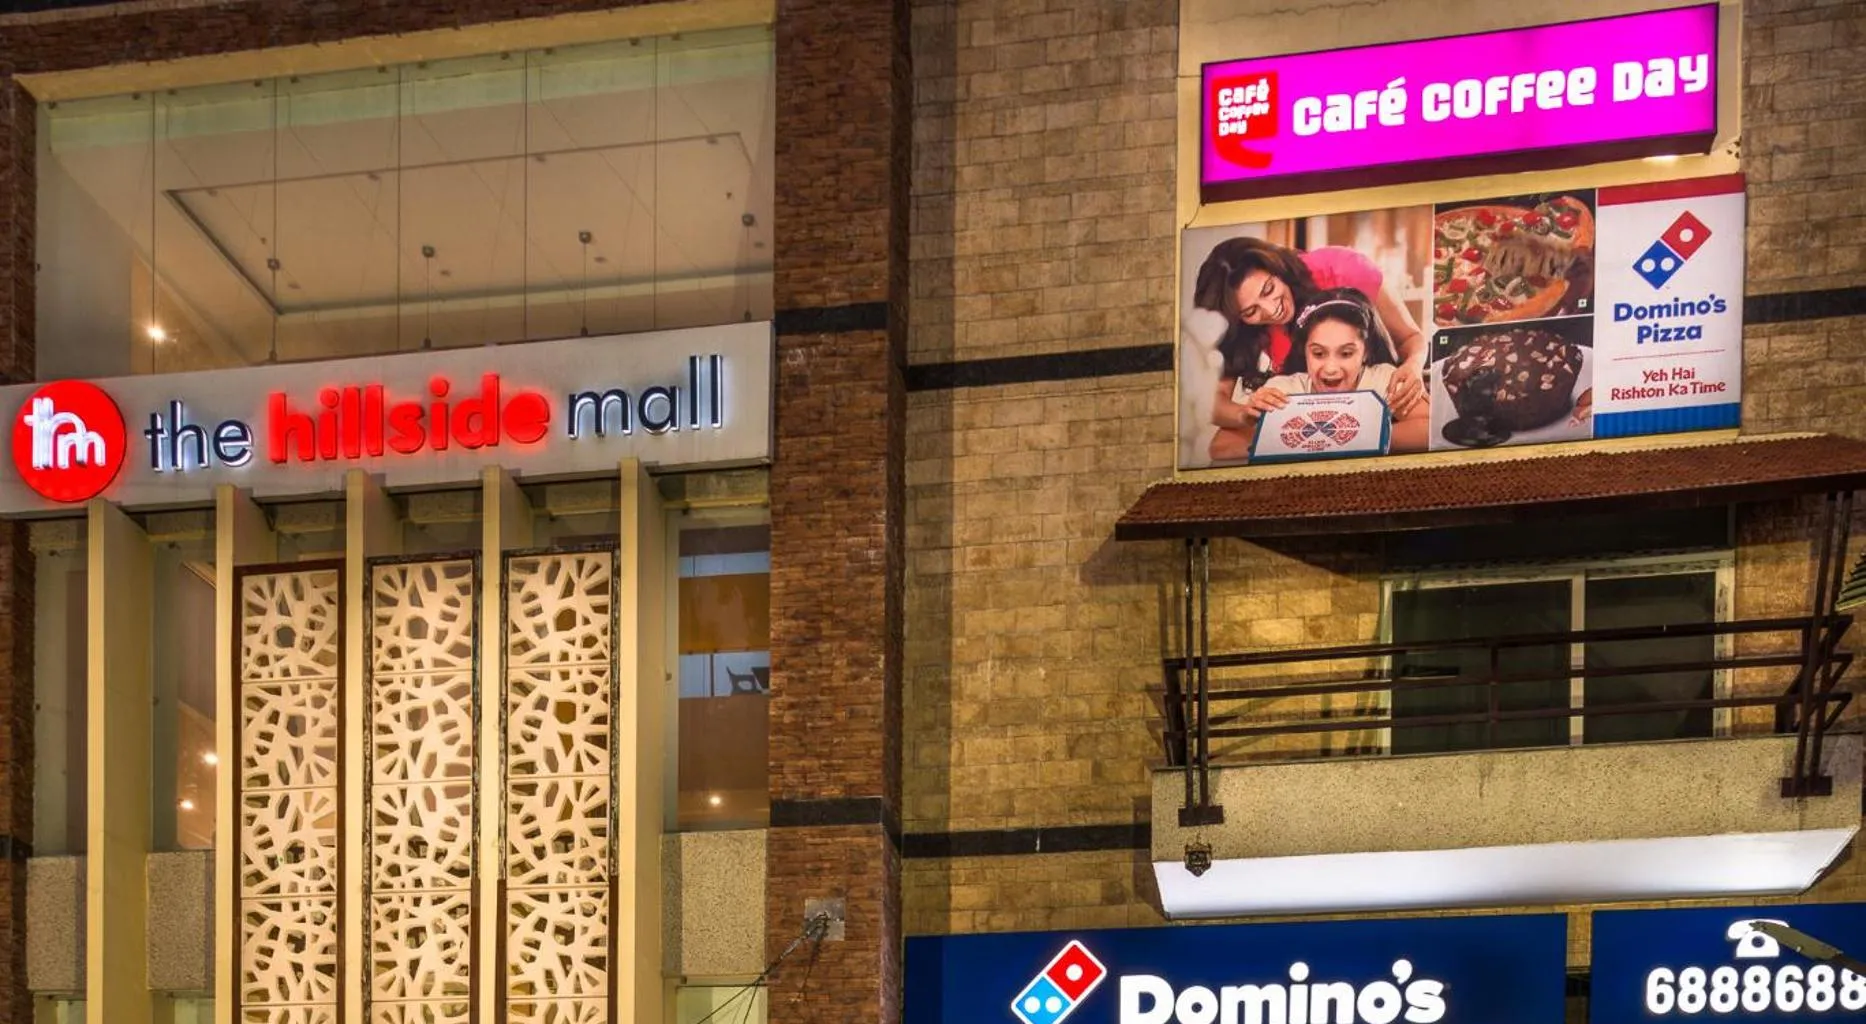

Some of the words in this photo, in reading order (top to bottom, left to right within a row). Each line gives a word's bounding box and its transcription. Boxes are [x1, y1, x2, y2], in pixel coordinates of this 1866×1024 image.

[1421, 66, 1597, 123] Coffee
[1612, 53, 1710, 103] Day
[1613, 293, 1727, 322] Domino's
[1636, 322, 1703, 344] Pizza
[1642, 369, 1669, 384] Yeh
[1671, 367, 1696, 381] Hai
[1611, 387, 1665, 401] Rishton
[1668, 383, 1688, 397] Ka
[1689, 381, 1727, 395] Time
[143, 400, 253, 473] the
[266, 373, 552, 464] hillside
[567, 355, 723, 438] mall
